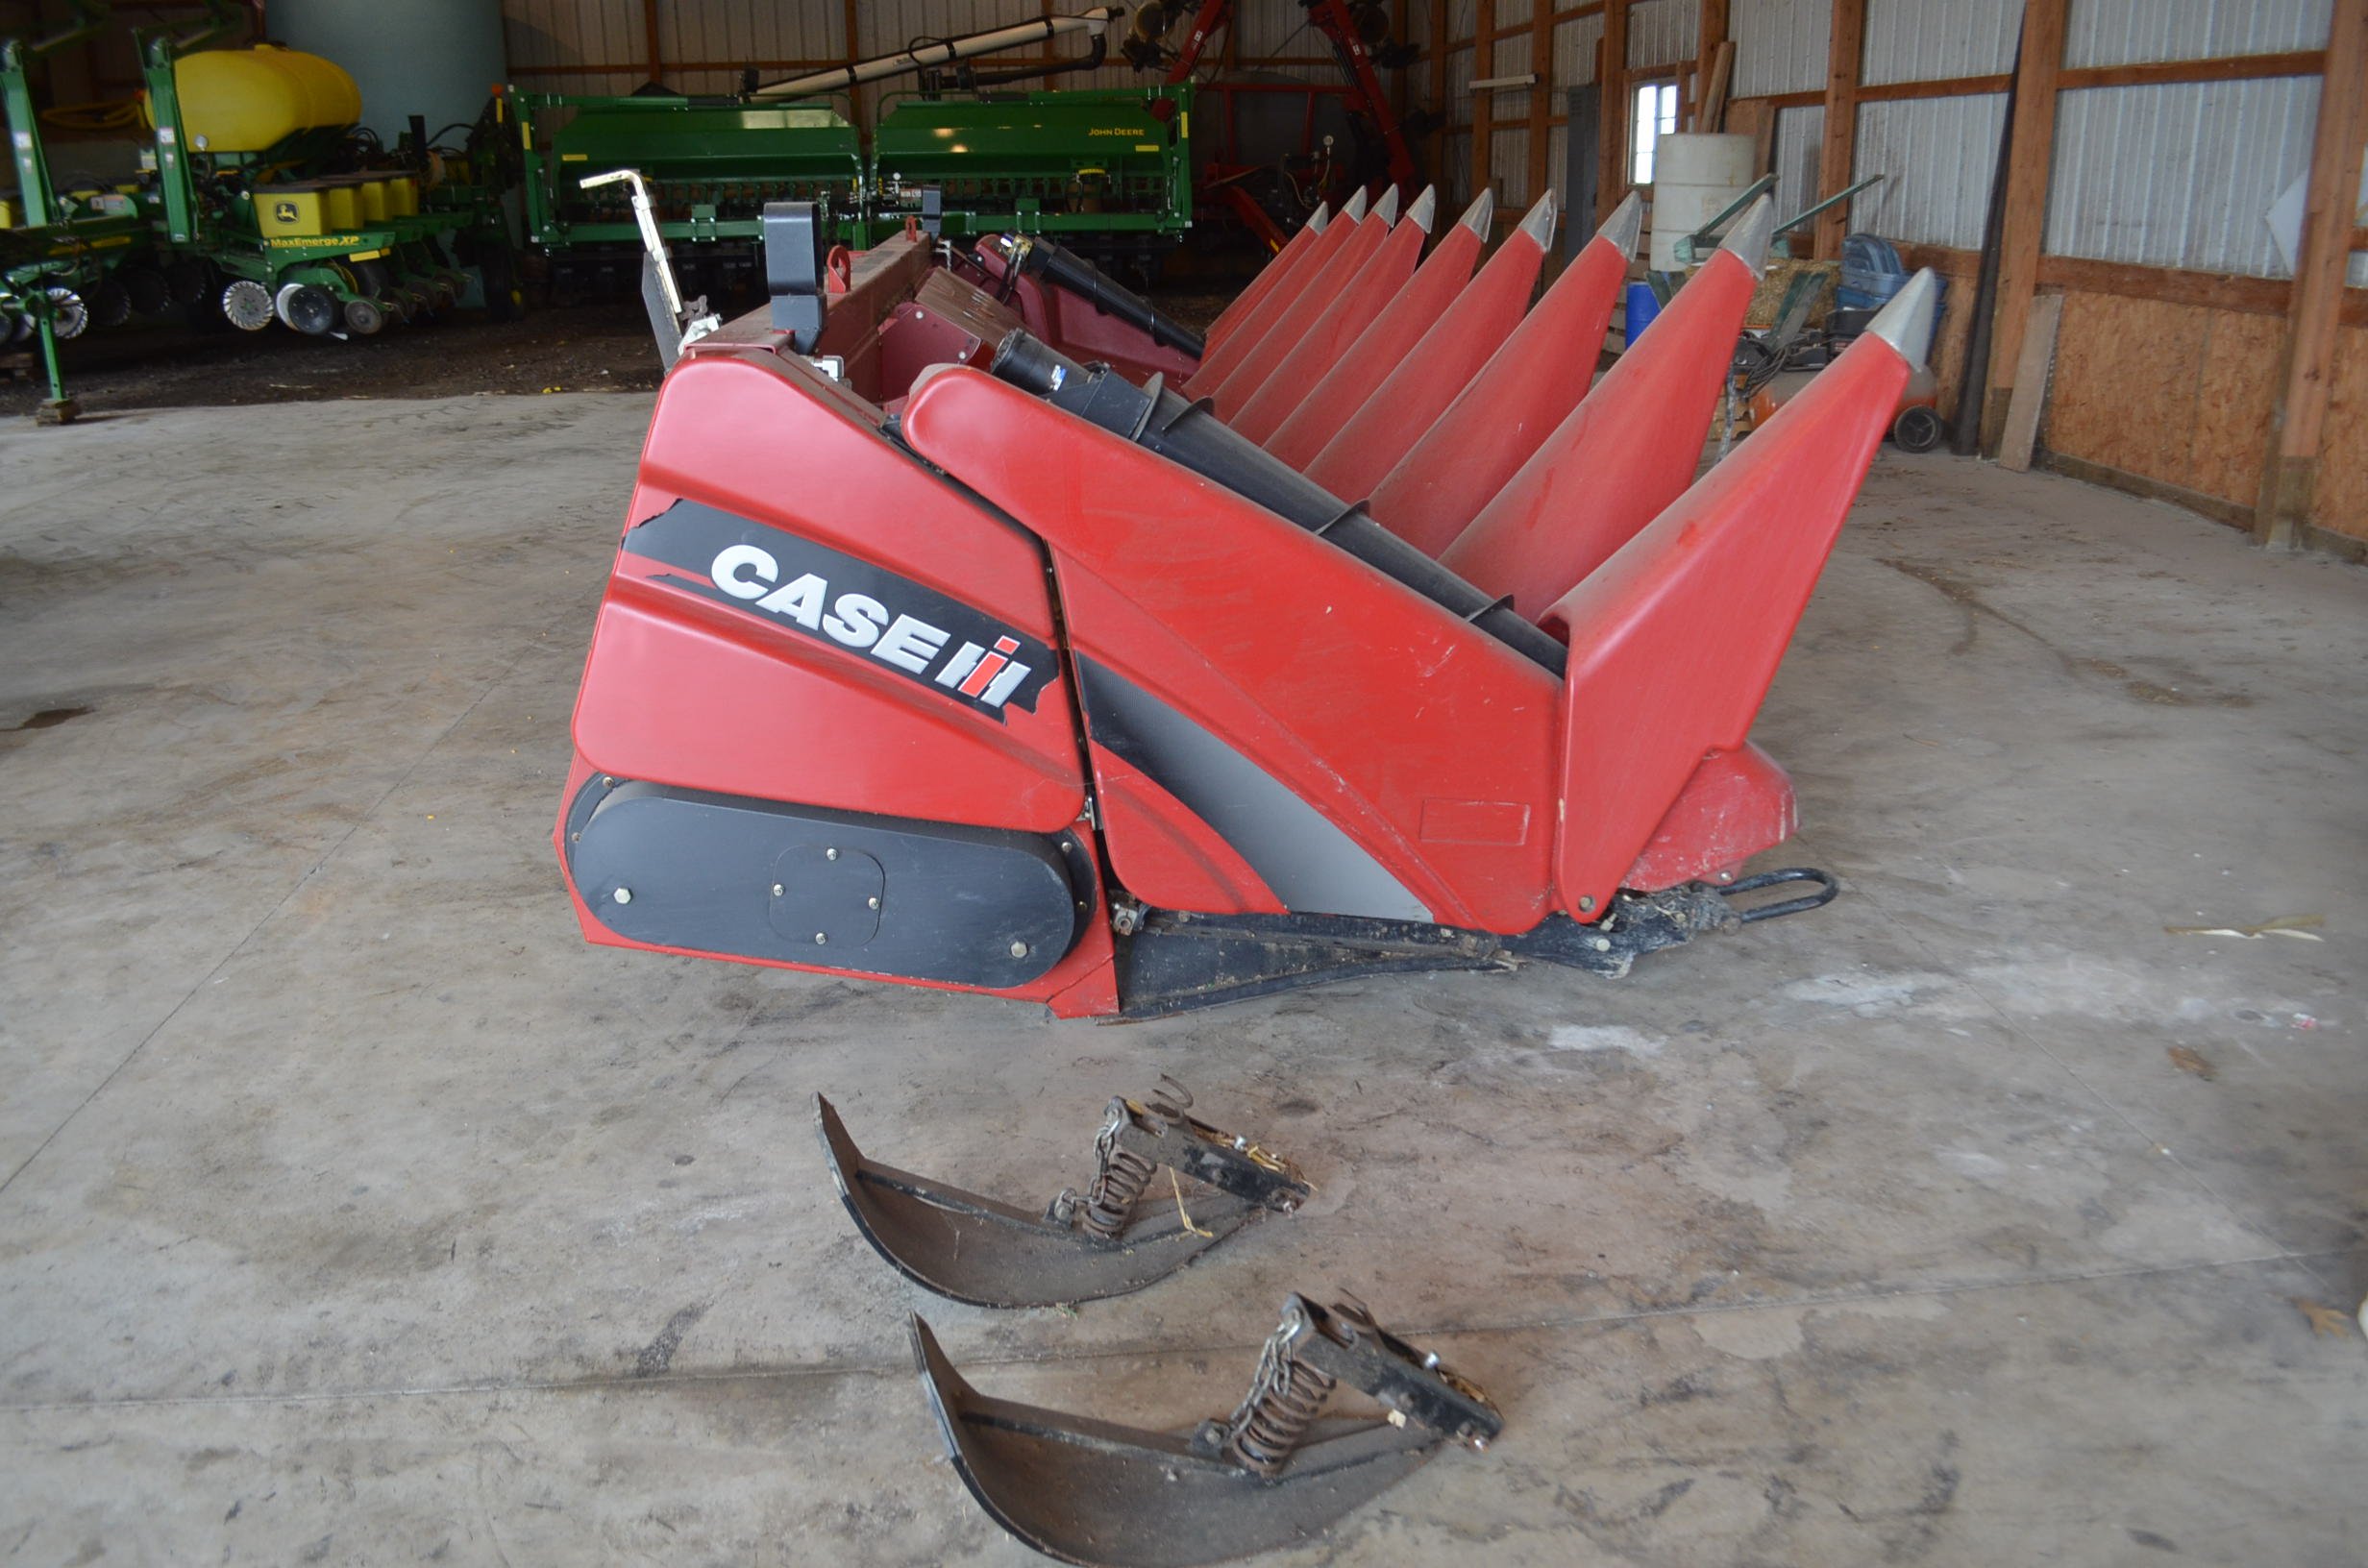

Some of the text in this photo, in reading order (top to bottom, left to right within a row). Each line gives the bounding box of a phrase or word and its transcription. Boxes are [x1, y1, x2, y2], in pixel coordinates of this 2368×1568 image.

[1088, 128, 1145, 136] JOHN DEERE
[270, 235, 360, 247] MaxEmerge XP
[710, 544, 951, 674] CASE
